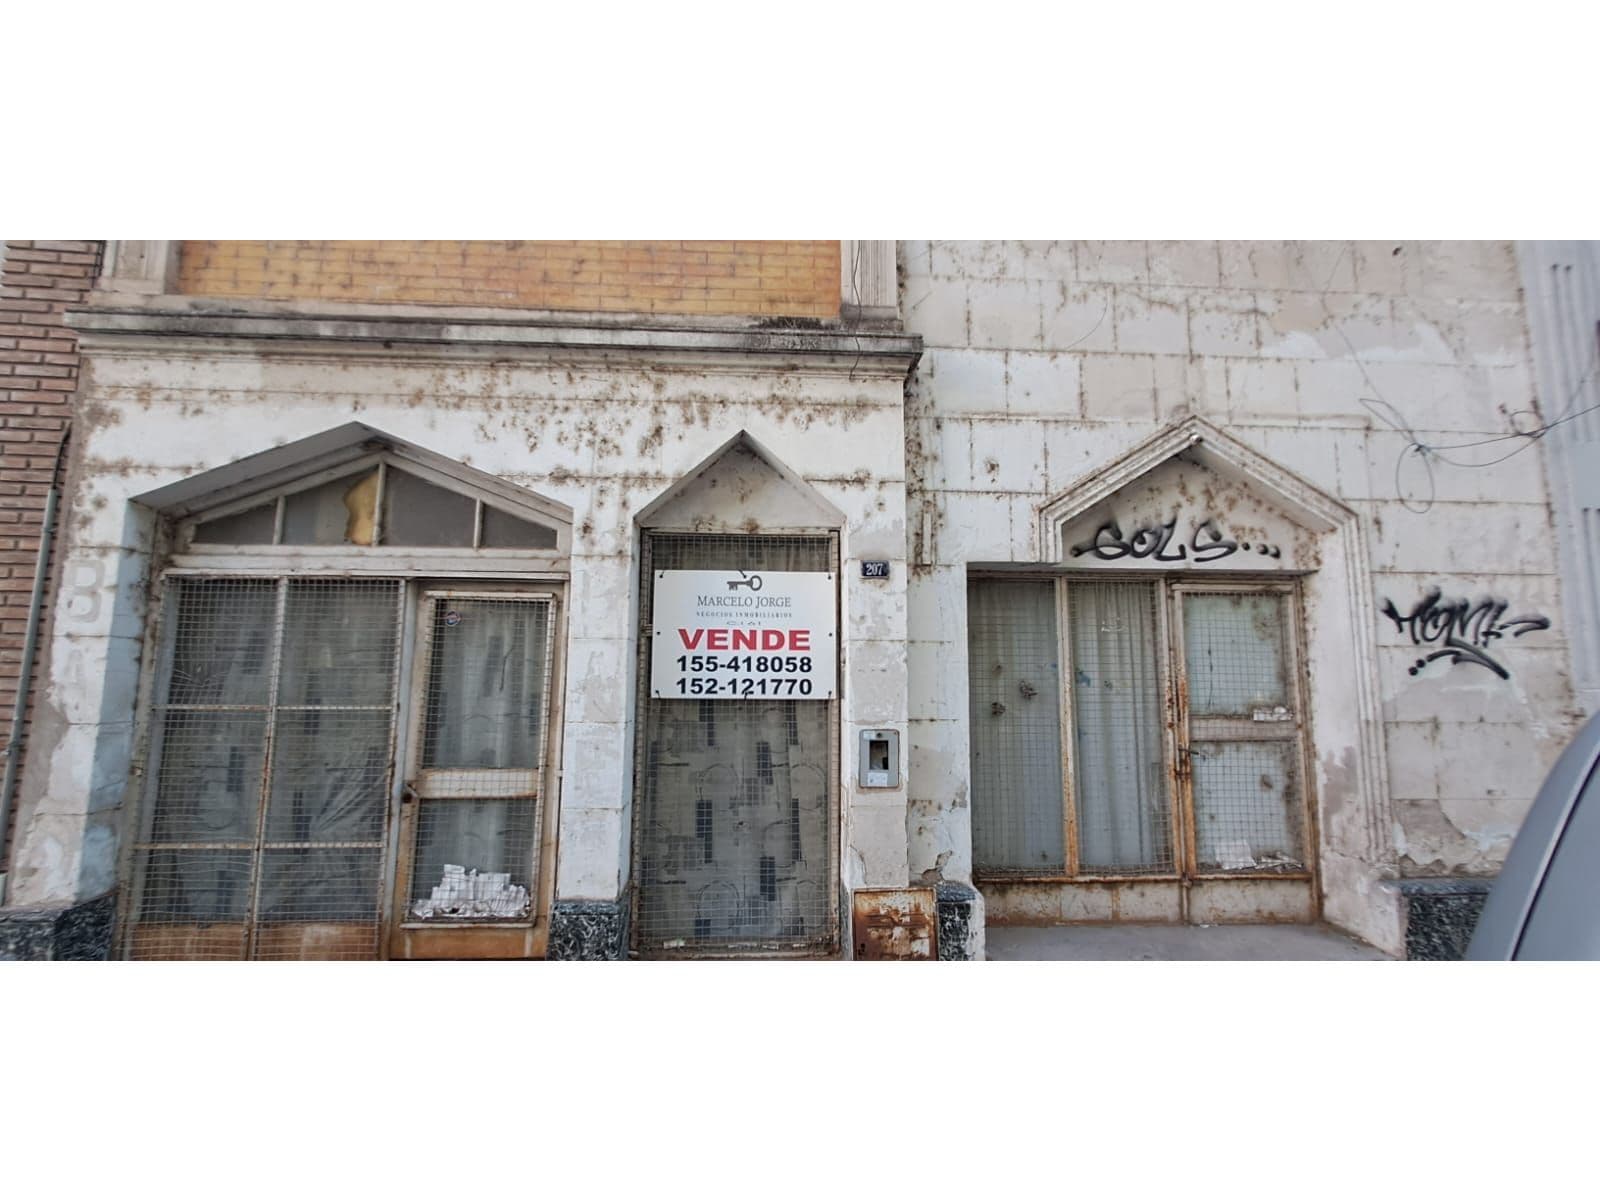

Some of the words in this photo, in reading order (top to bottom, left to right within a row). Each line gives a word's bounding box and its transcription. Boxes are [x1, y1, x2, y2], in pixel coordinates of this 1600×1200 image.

[865, 563, 884, 576] 207
[697, 595, 753, 608] MARCELO
[755, 596, 792, 609] JORGE
[678, 628, 811, 651] VENDE
[676, 656, 812, 673] 155-418058
[676, 678, 813, 695] 152-121770
